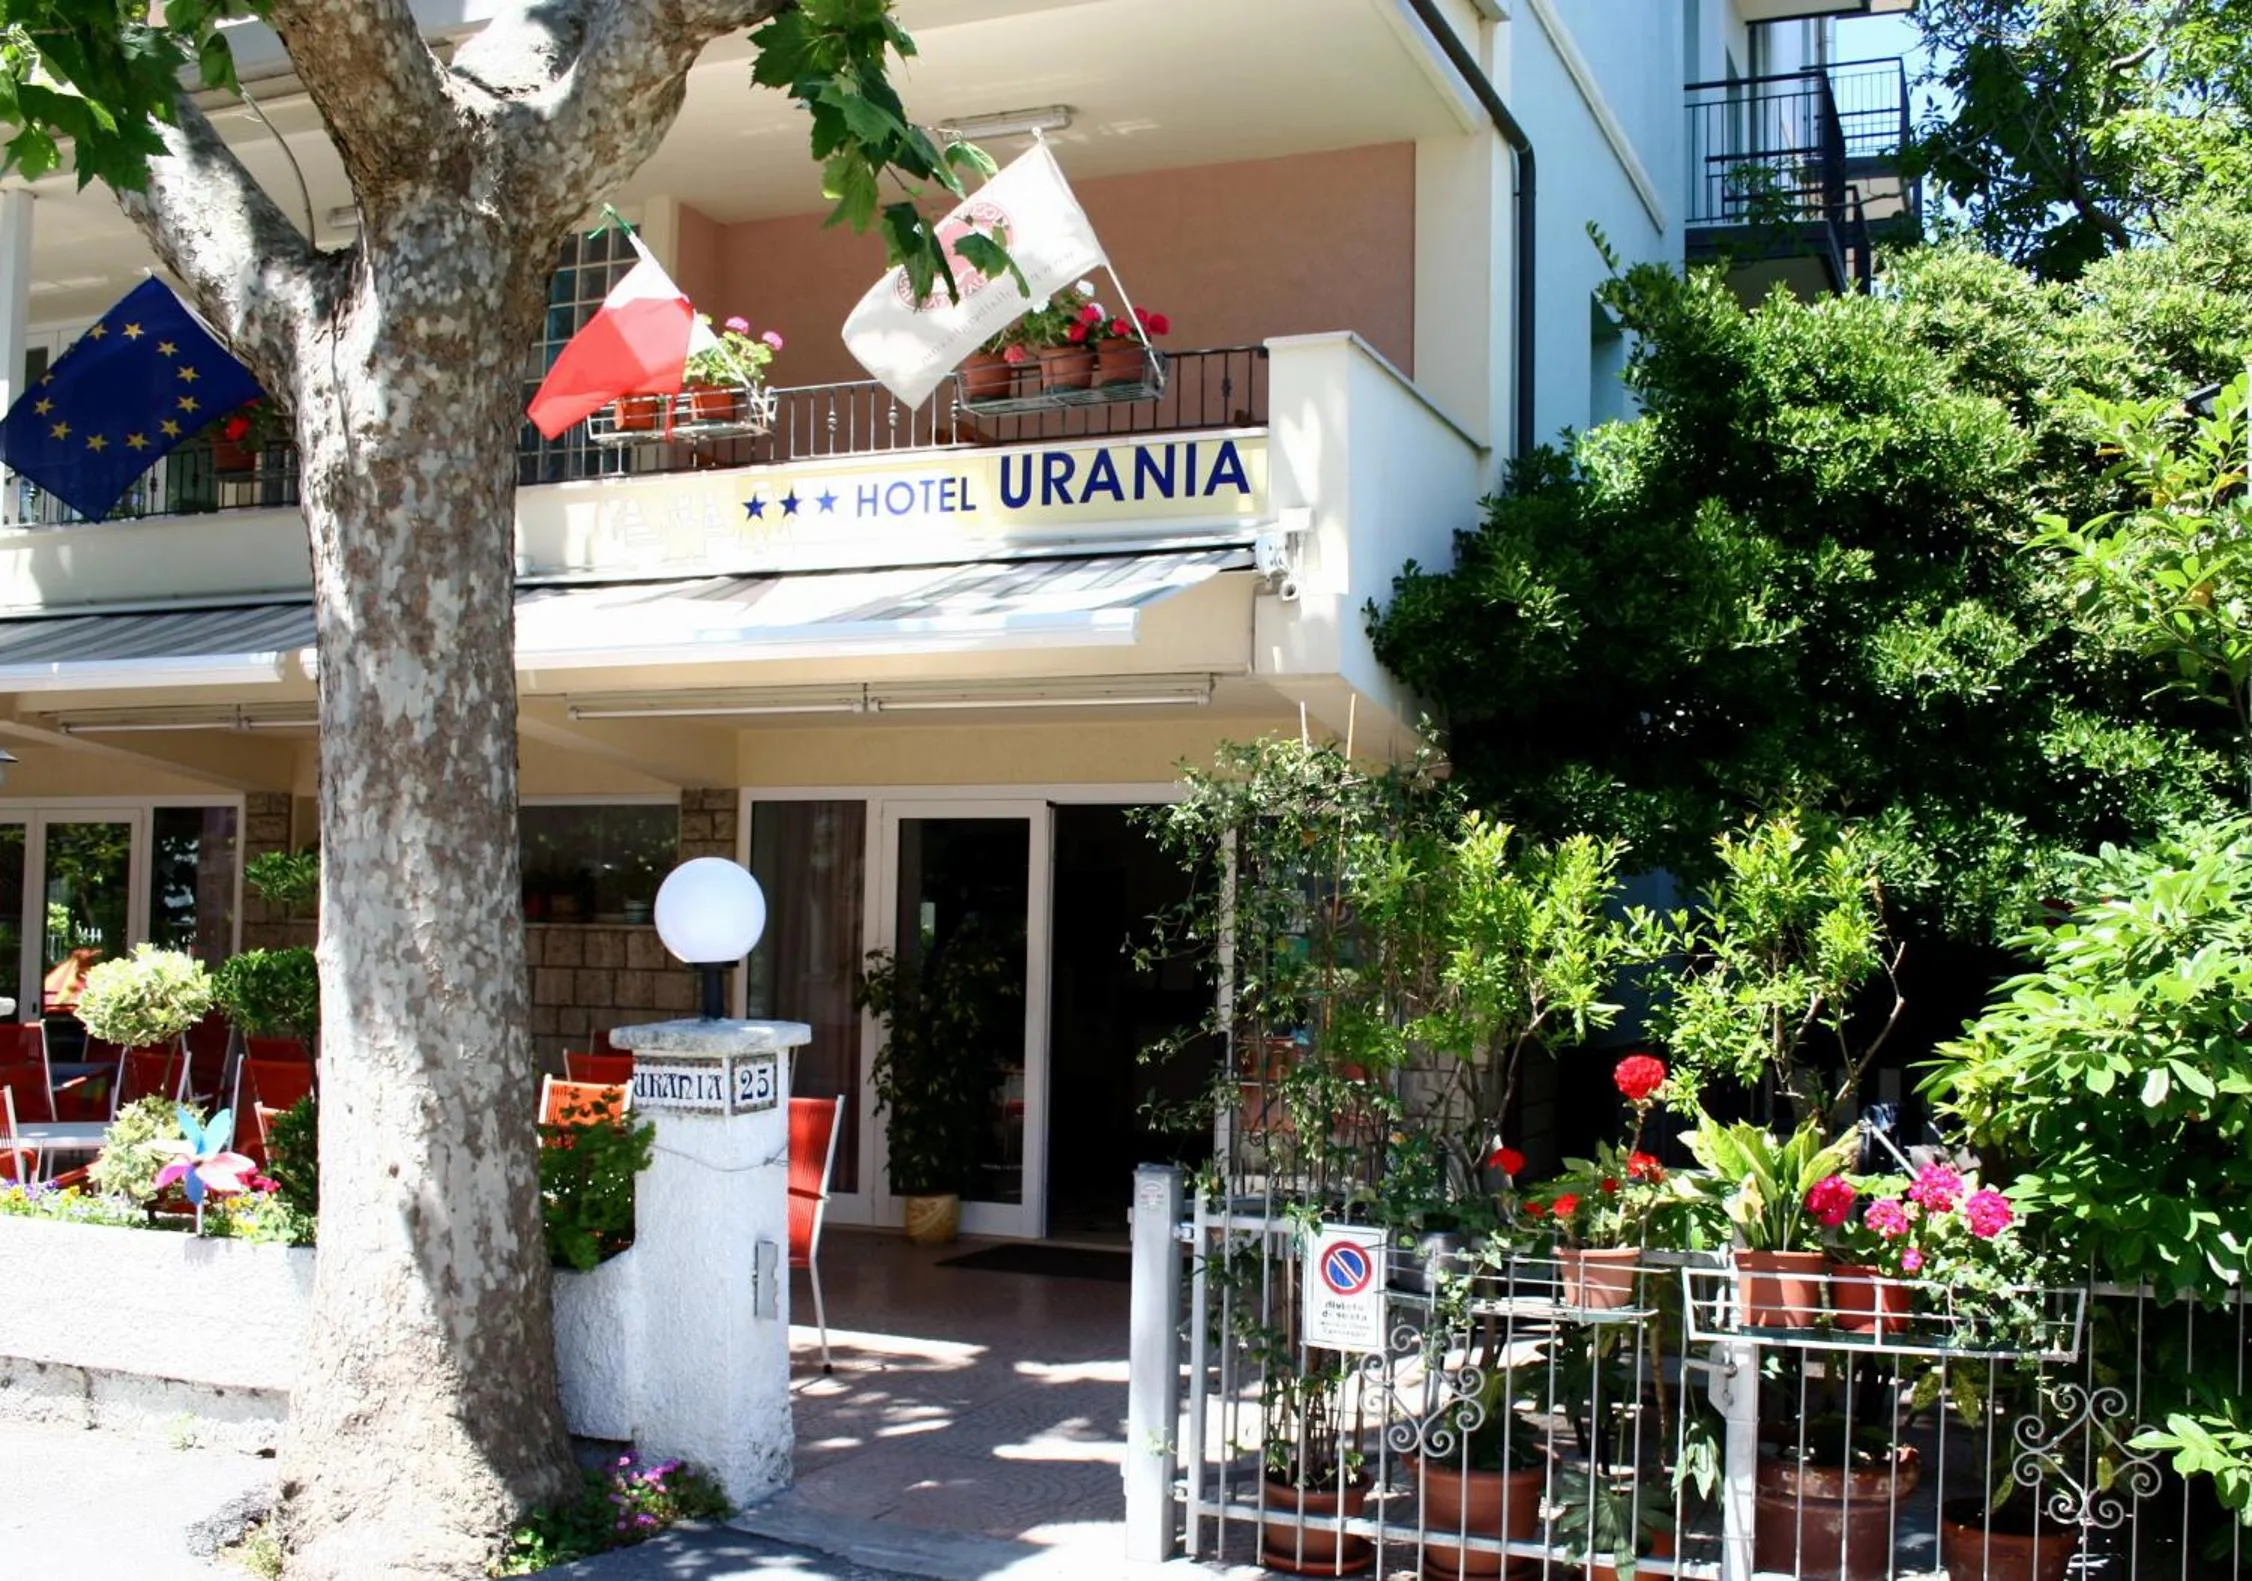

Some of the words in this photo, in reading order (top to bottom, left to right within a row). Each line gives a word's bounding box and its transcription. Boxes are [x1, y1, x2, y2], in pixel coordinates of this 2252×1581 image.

[857, 477, 976, 516] HOTEL
[1000, 441, 1251, 508] URANIA
[634, 1072, 722, 1100] URANIA
[741, 1068, 769, 1101] 25
